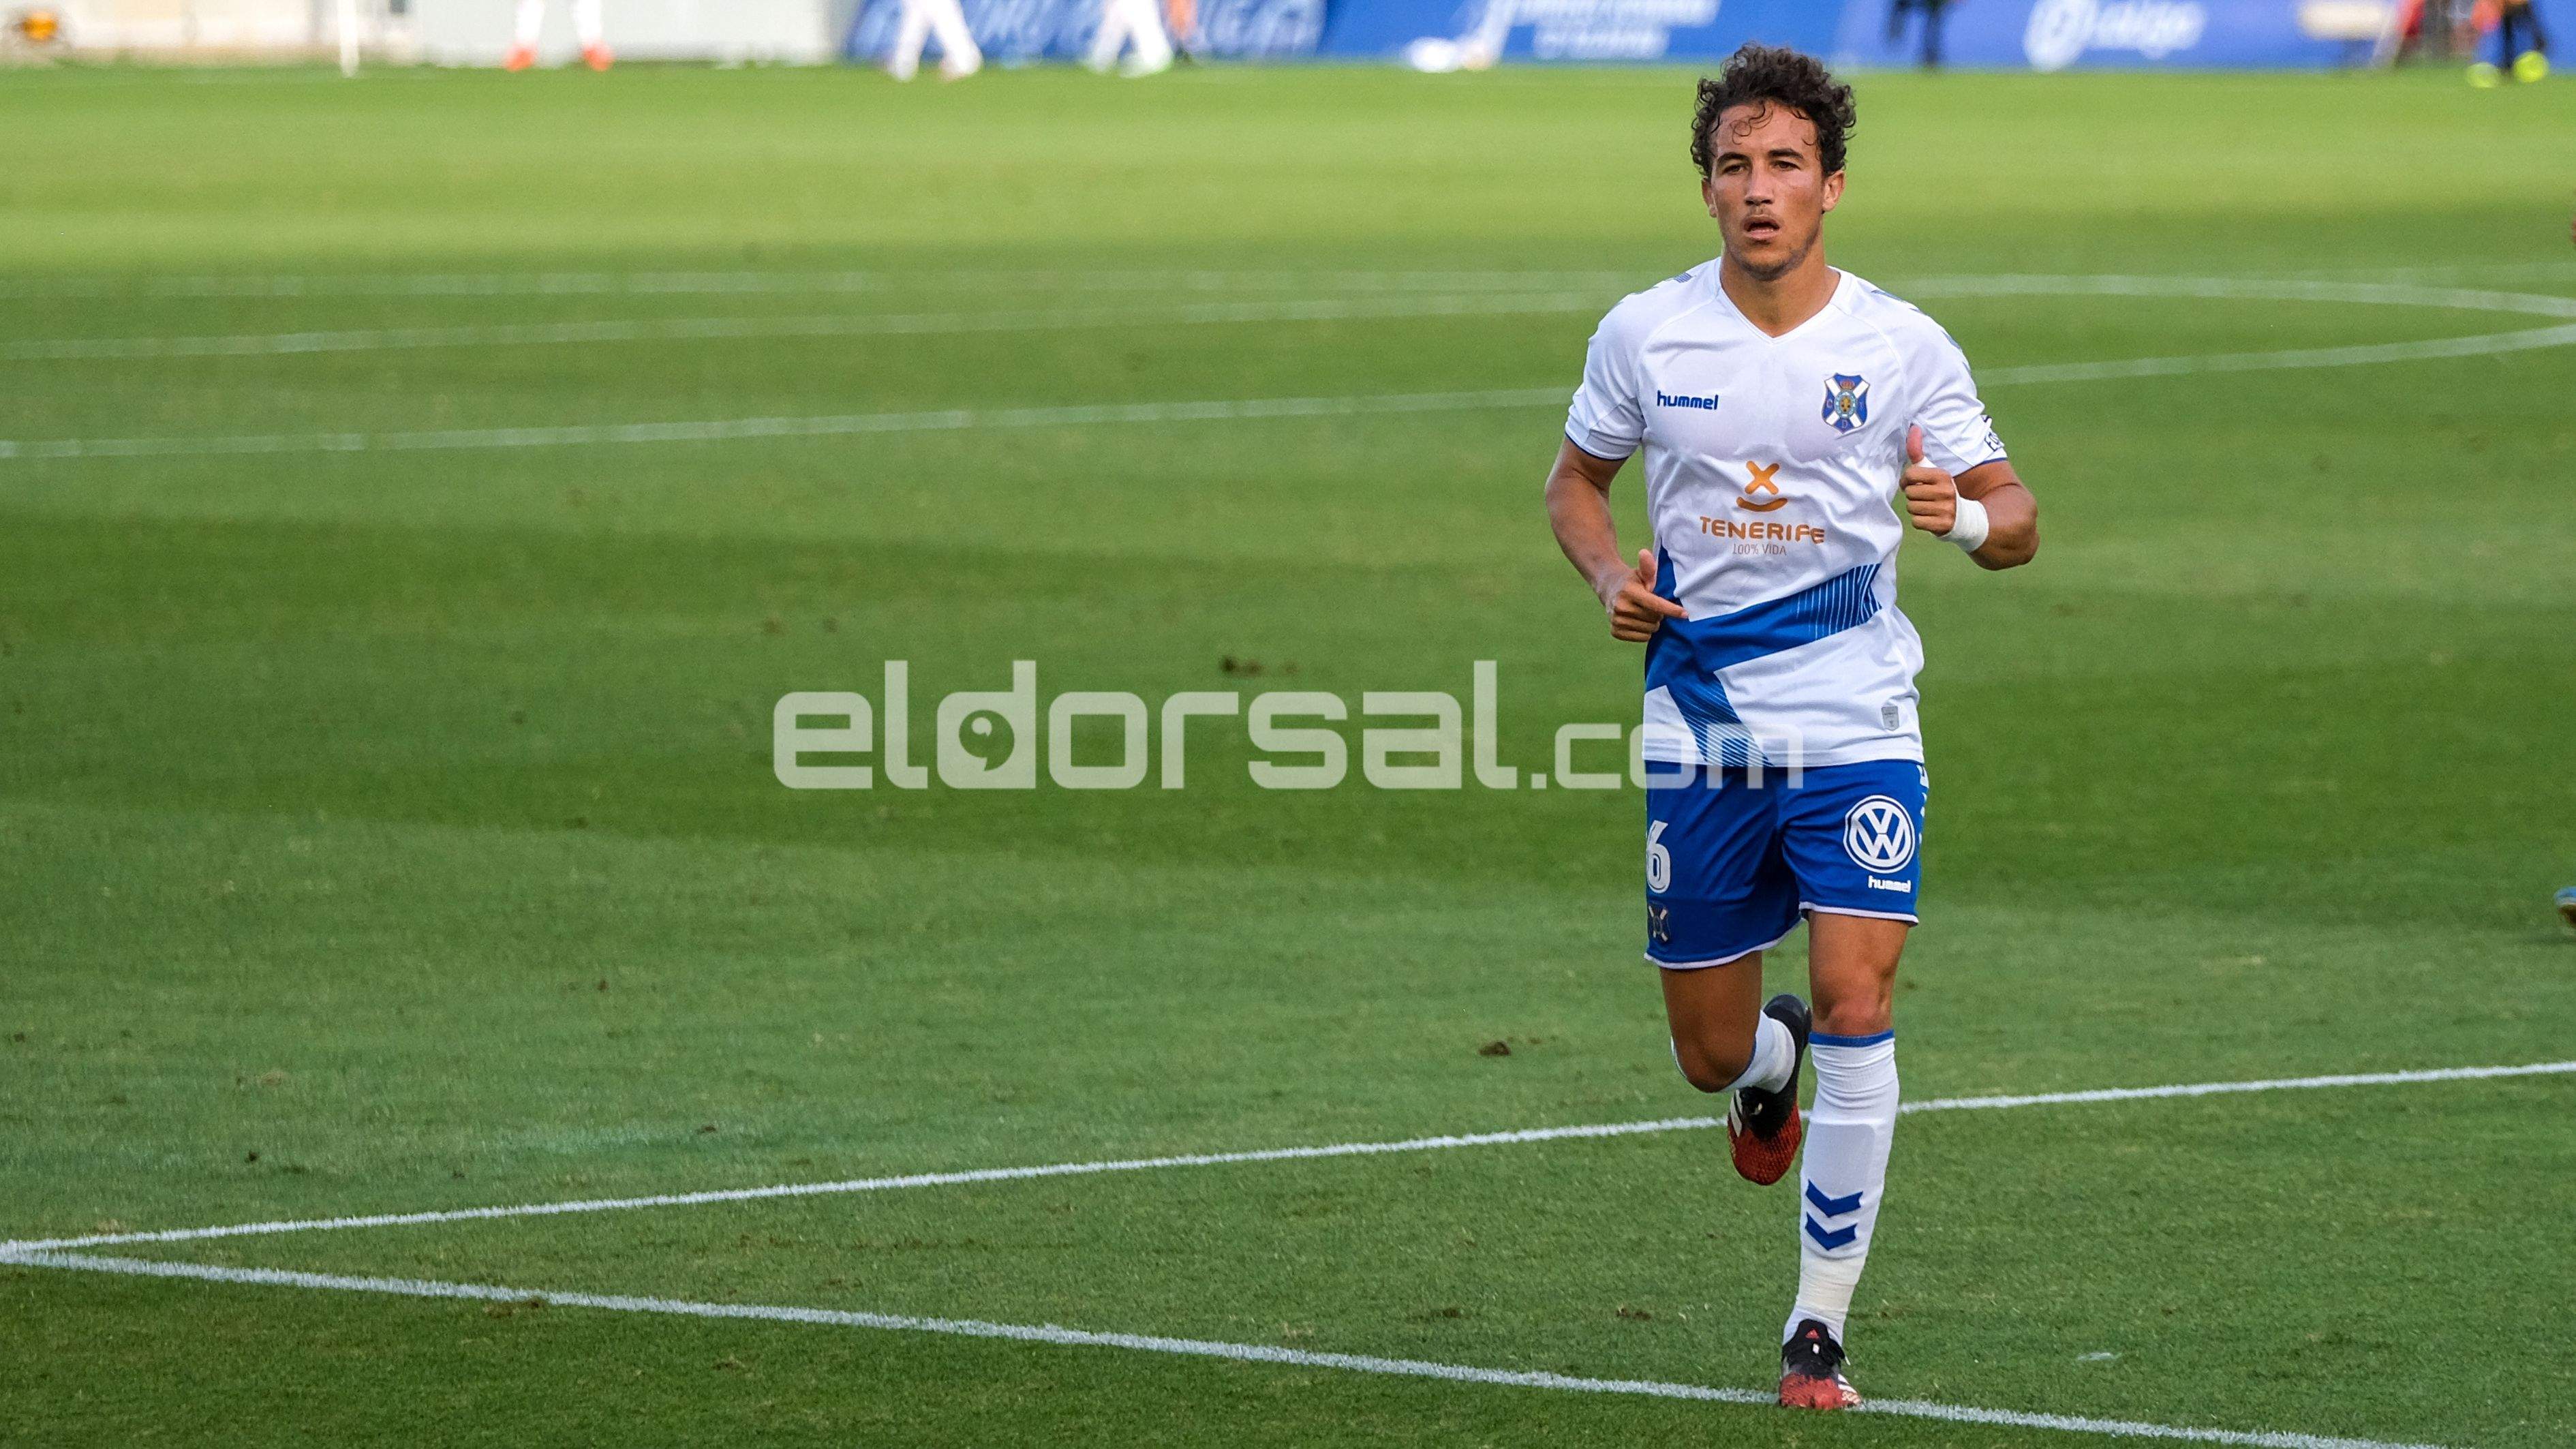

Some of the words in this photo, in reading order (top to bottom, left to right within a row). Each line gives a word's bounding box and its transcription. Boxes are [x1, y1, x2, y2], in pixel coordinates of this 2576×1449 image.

[1656, 390, 1719, 410] hummel
[1700, 516, 1825, 545] TENERIFE
[1732, 543, 1759, 555] 100%
[1762, 543, 1788, 556] VIDA
[1646, 820, 1671, 894] 6
